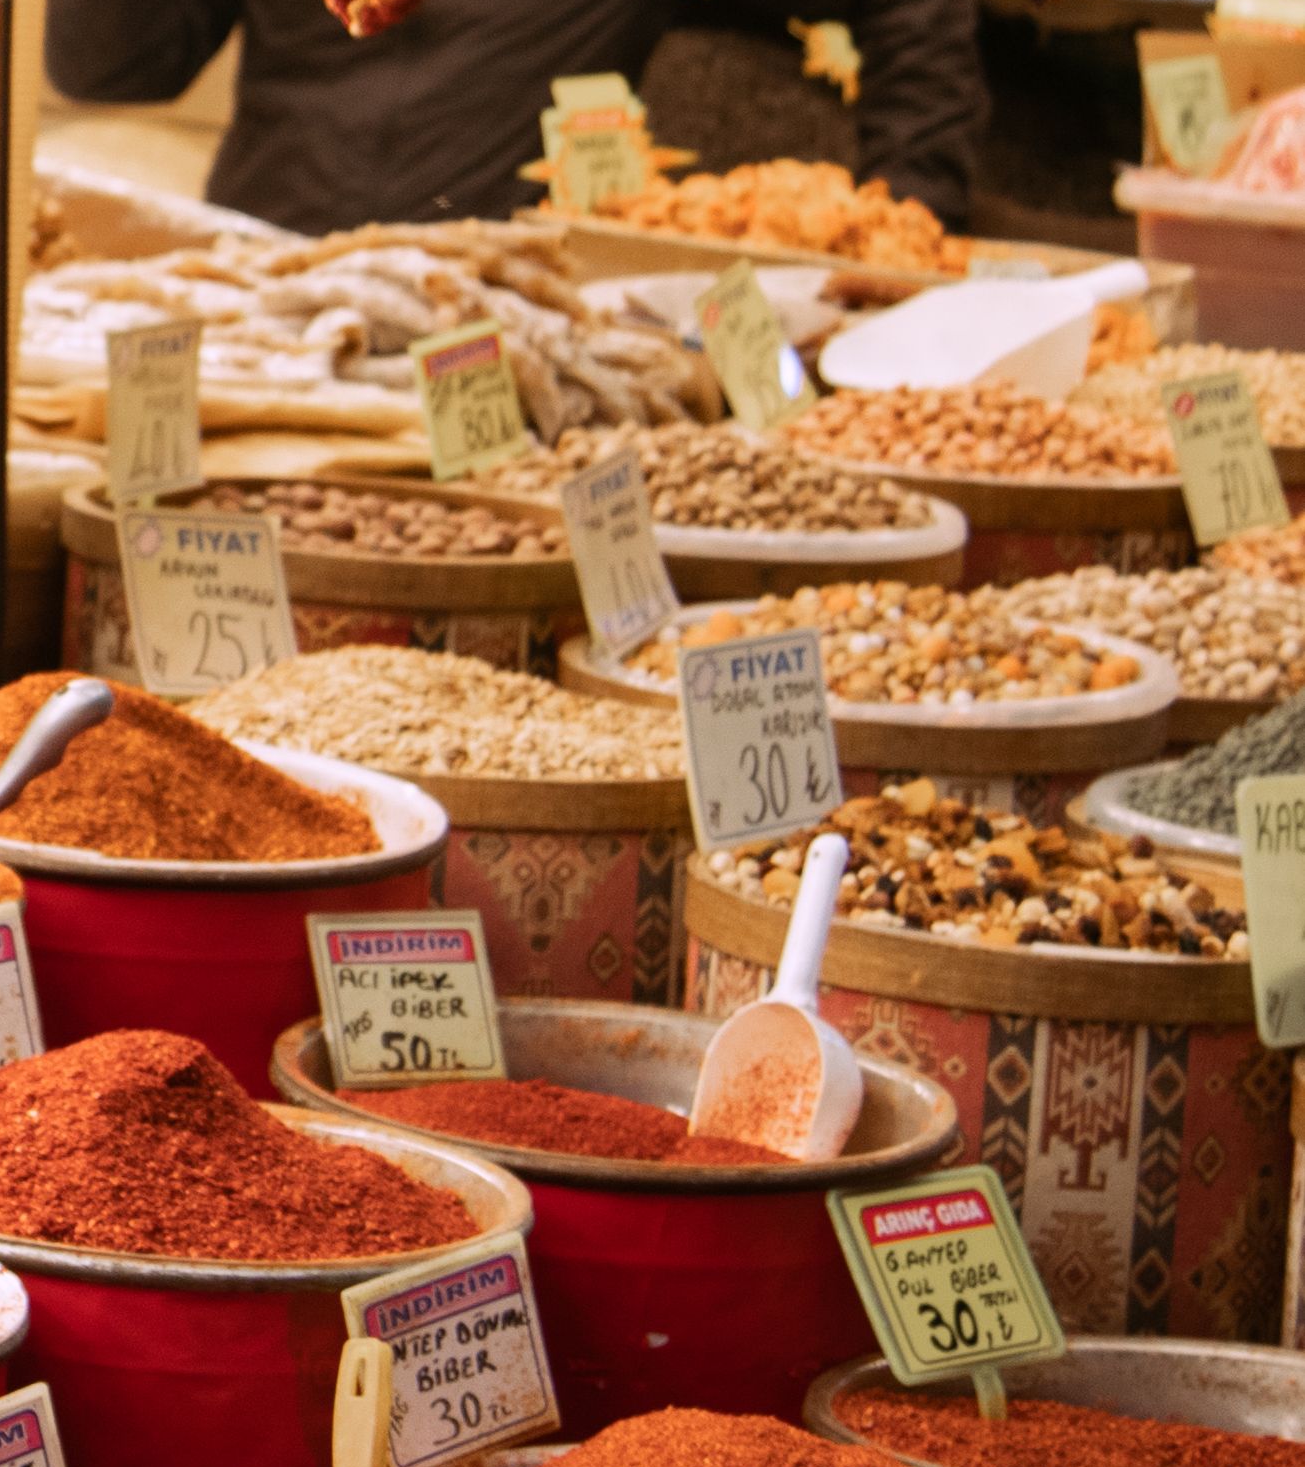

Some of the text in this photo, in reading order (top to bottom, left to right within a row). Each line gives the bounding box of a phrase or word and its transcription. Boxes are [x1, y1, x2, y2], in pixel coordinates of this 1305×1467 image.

[739, 741, 790, 826] 30
[339, 935, 463, 958] İNDİRİM
[338, 967, 380, 990] ACI
[379, 1030, 433, 1073] 50
[873, 1199, 985, 1238] ARINÇ GIDA
[377, 1266, 507, 1335] İNDİRİM
[897, 1278, 935, 1300] PUL
[392, 1326, 448, 1366] NTEP
[429, 1390, 484, 1447] 30
